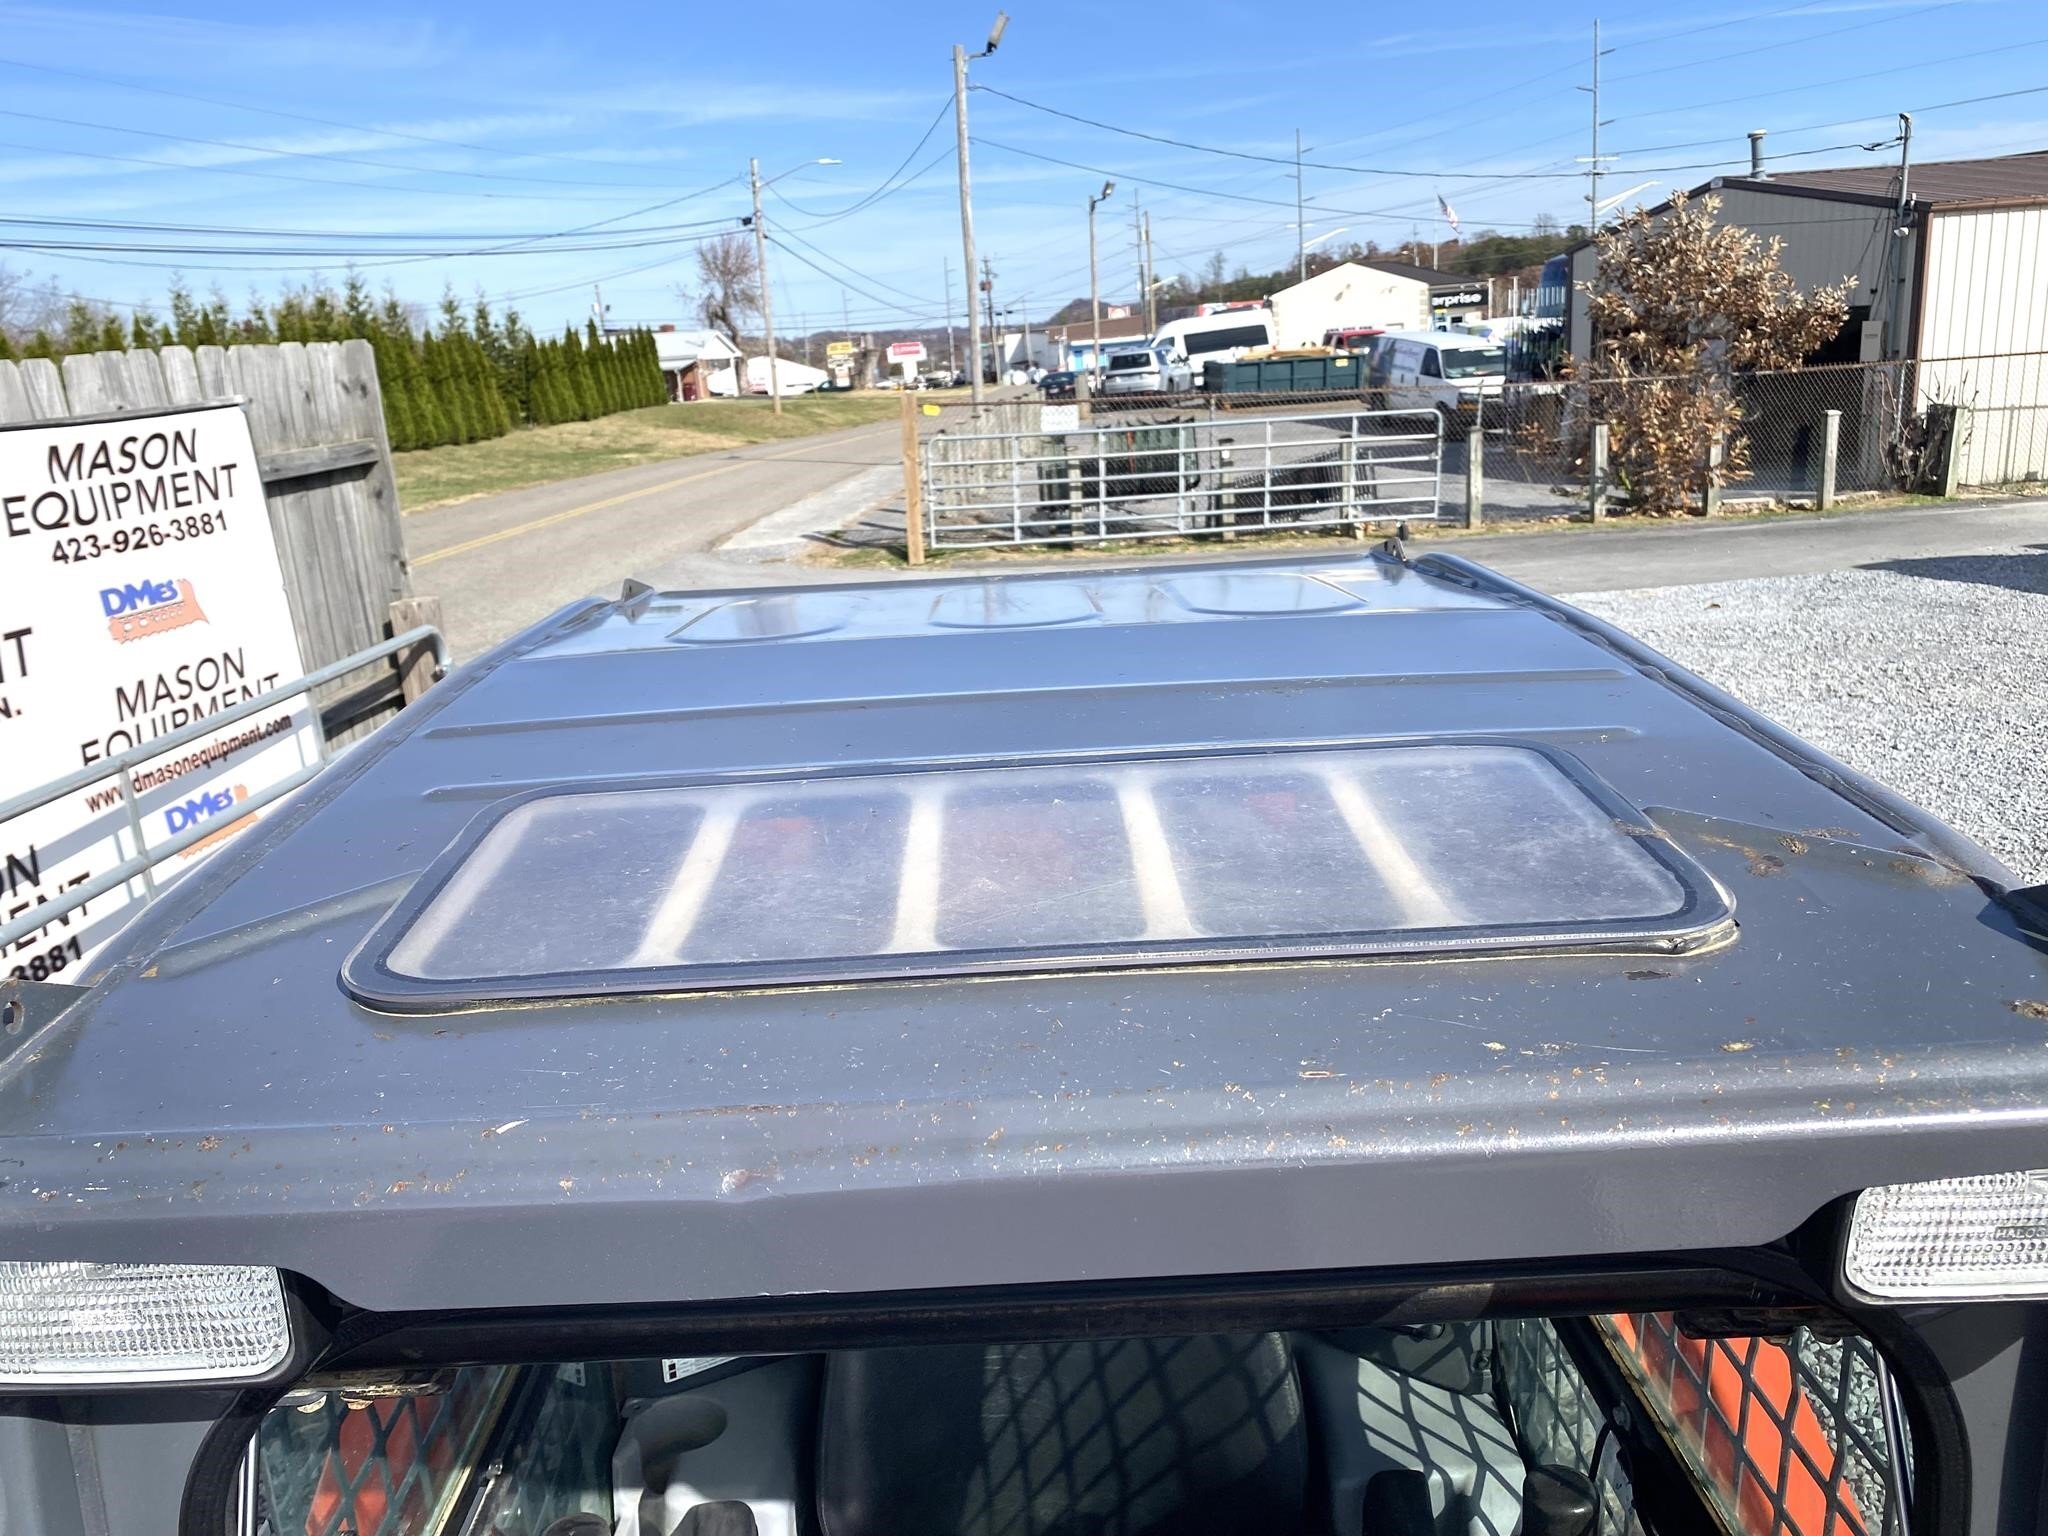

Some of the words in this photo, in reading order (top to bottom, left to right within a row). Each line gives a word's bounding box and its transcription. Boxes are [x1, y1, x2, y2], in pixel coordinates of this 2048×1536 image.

[48, 428, 197, 484] MASON
[2, 463, 237, 537] EQUIPMENT
[52, 509, 227, 564] 423-926-3881
[115, 647, 245, 722] MASON
[84, 714, 292, 813] wwdmasonequipment.com
